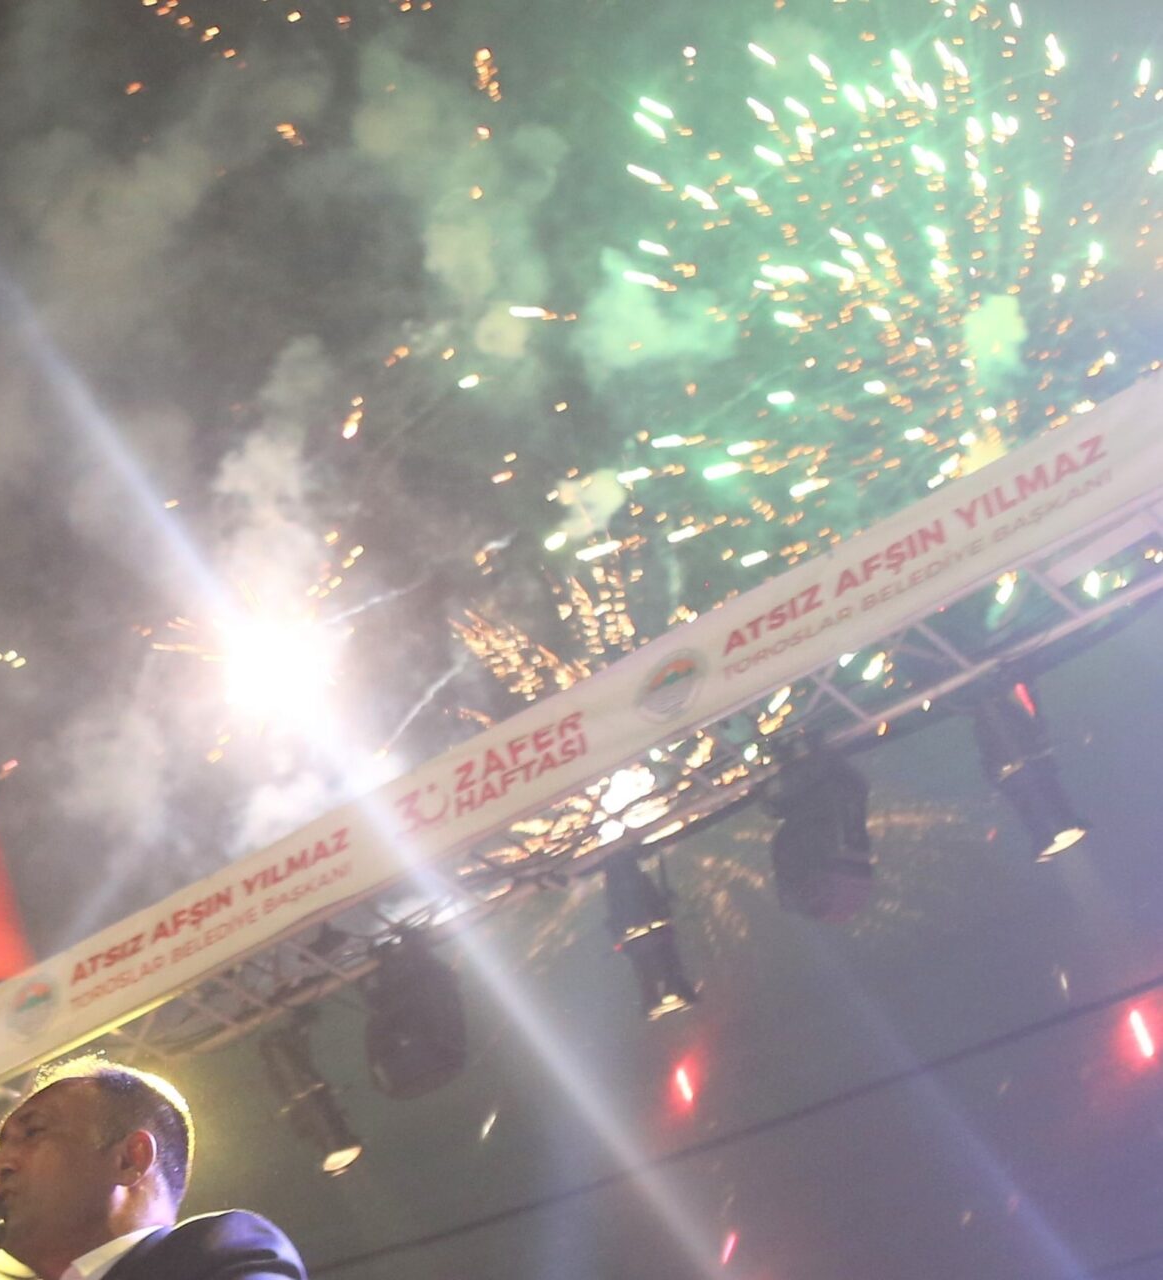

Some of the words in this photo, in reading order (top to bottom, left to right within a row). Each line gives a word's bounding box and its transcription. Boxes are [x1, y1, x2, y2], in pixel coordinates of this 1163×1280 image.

[723, 584, 823, 657] ATSIZ
[954, 434, 1108, 530] YILMAZ
[723, 606, 853, 680] TOROSLAR
[455, 711, 584, 793] ZAFER
[455, 733, 587, 817] HAFTASI
[70, 933, 146, 985] ATSIZ
[241, 828, 350, 896] YILMAZ
